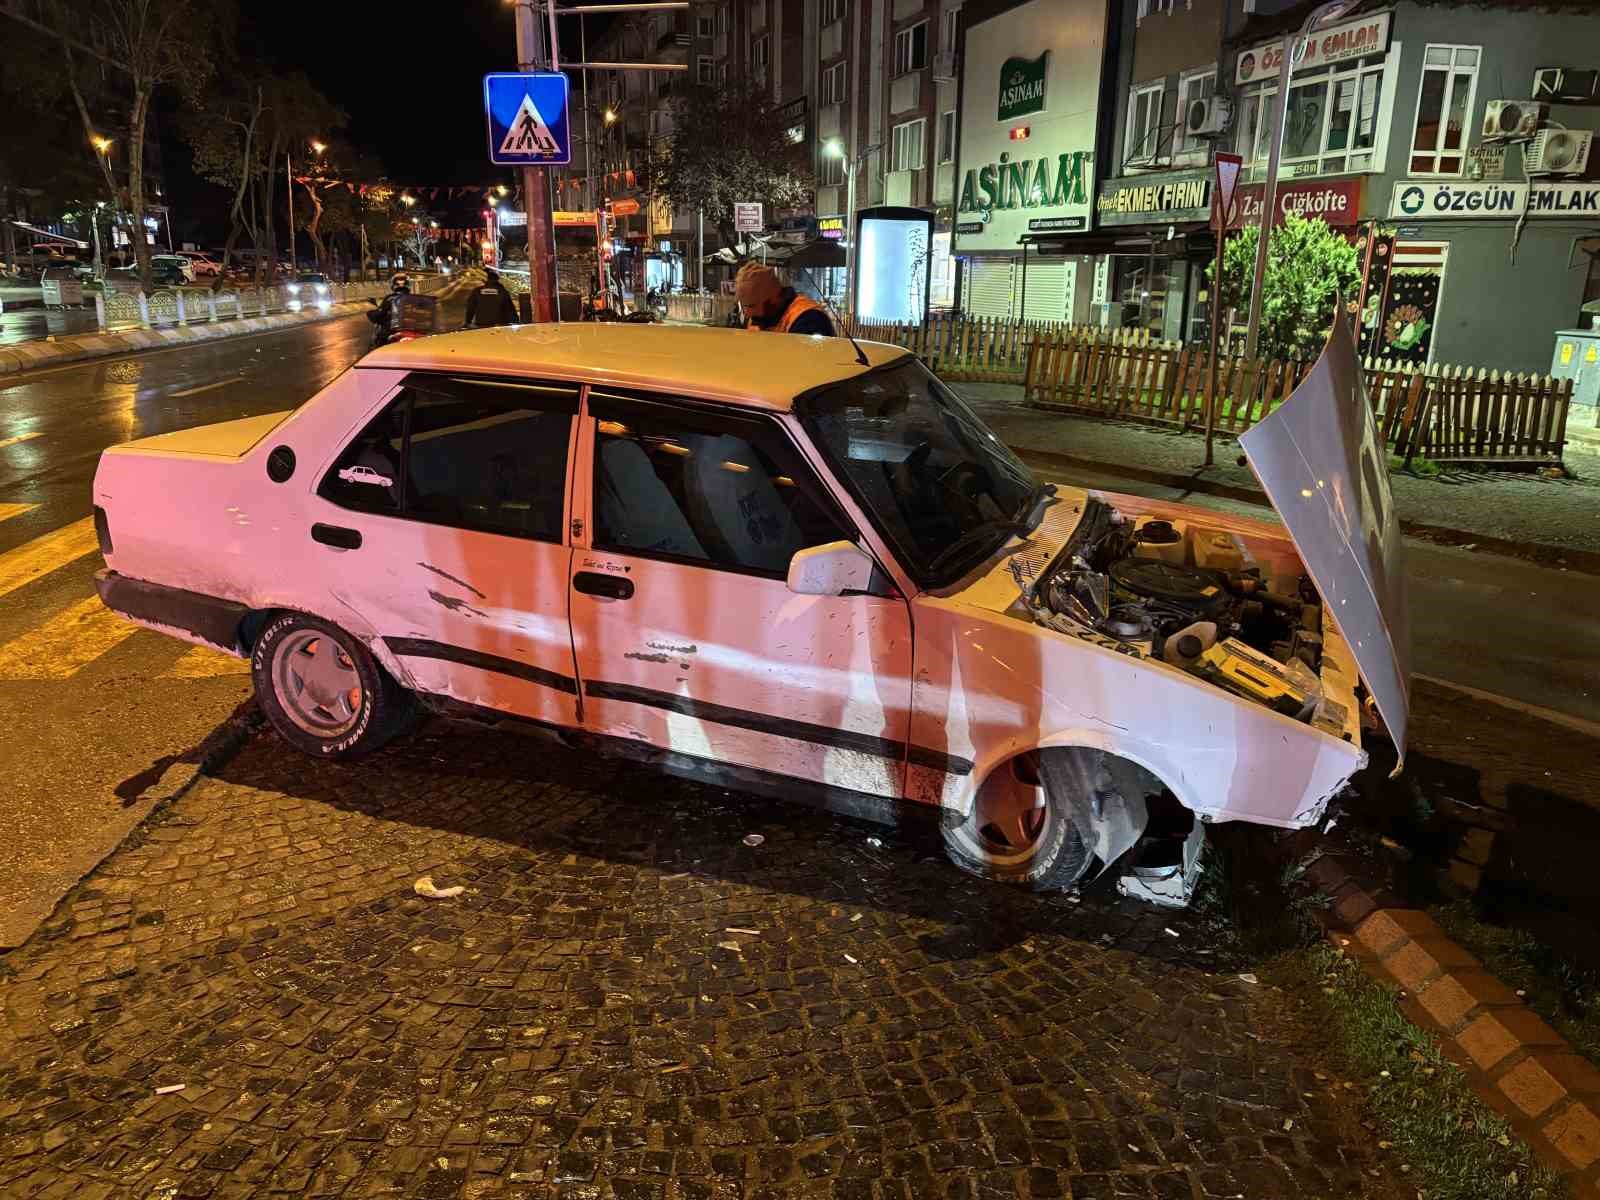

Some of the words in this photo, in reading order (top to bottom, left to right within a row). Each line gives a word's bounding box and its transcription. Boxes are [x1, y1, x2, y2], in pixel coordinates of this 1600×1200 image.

[1118, 186, 1163, 212] EKMEK
[1433, 186, 1515, 211] ÖZGÜN
[1527, 190, 1600, 211] EMLAK
[255, 616, 296, 670] VITOUR
